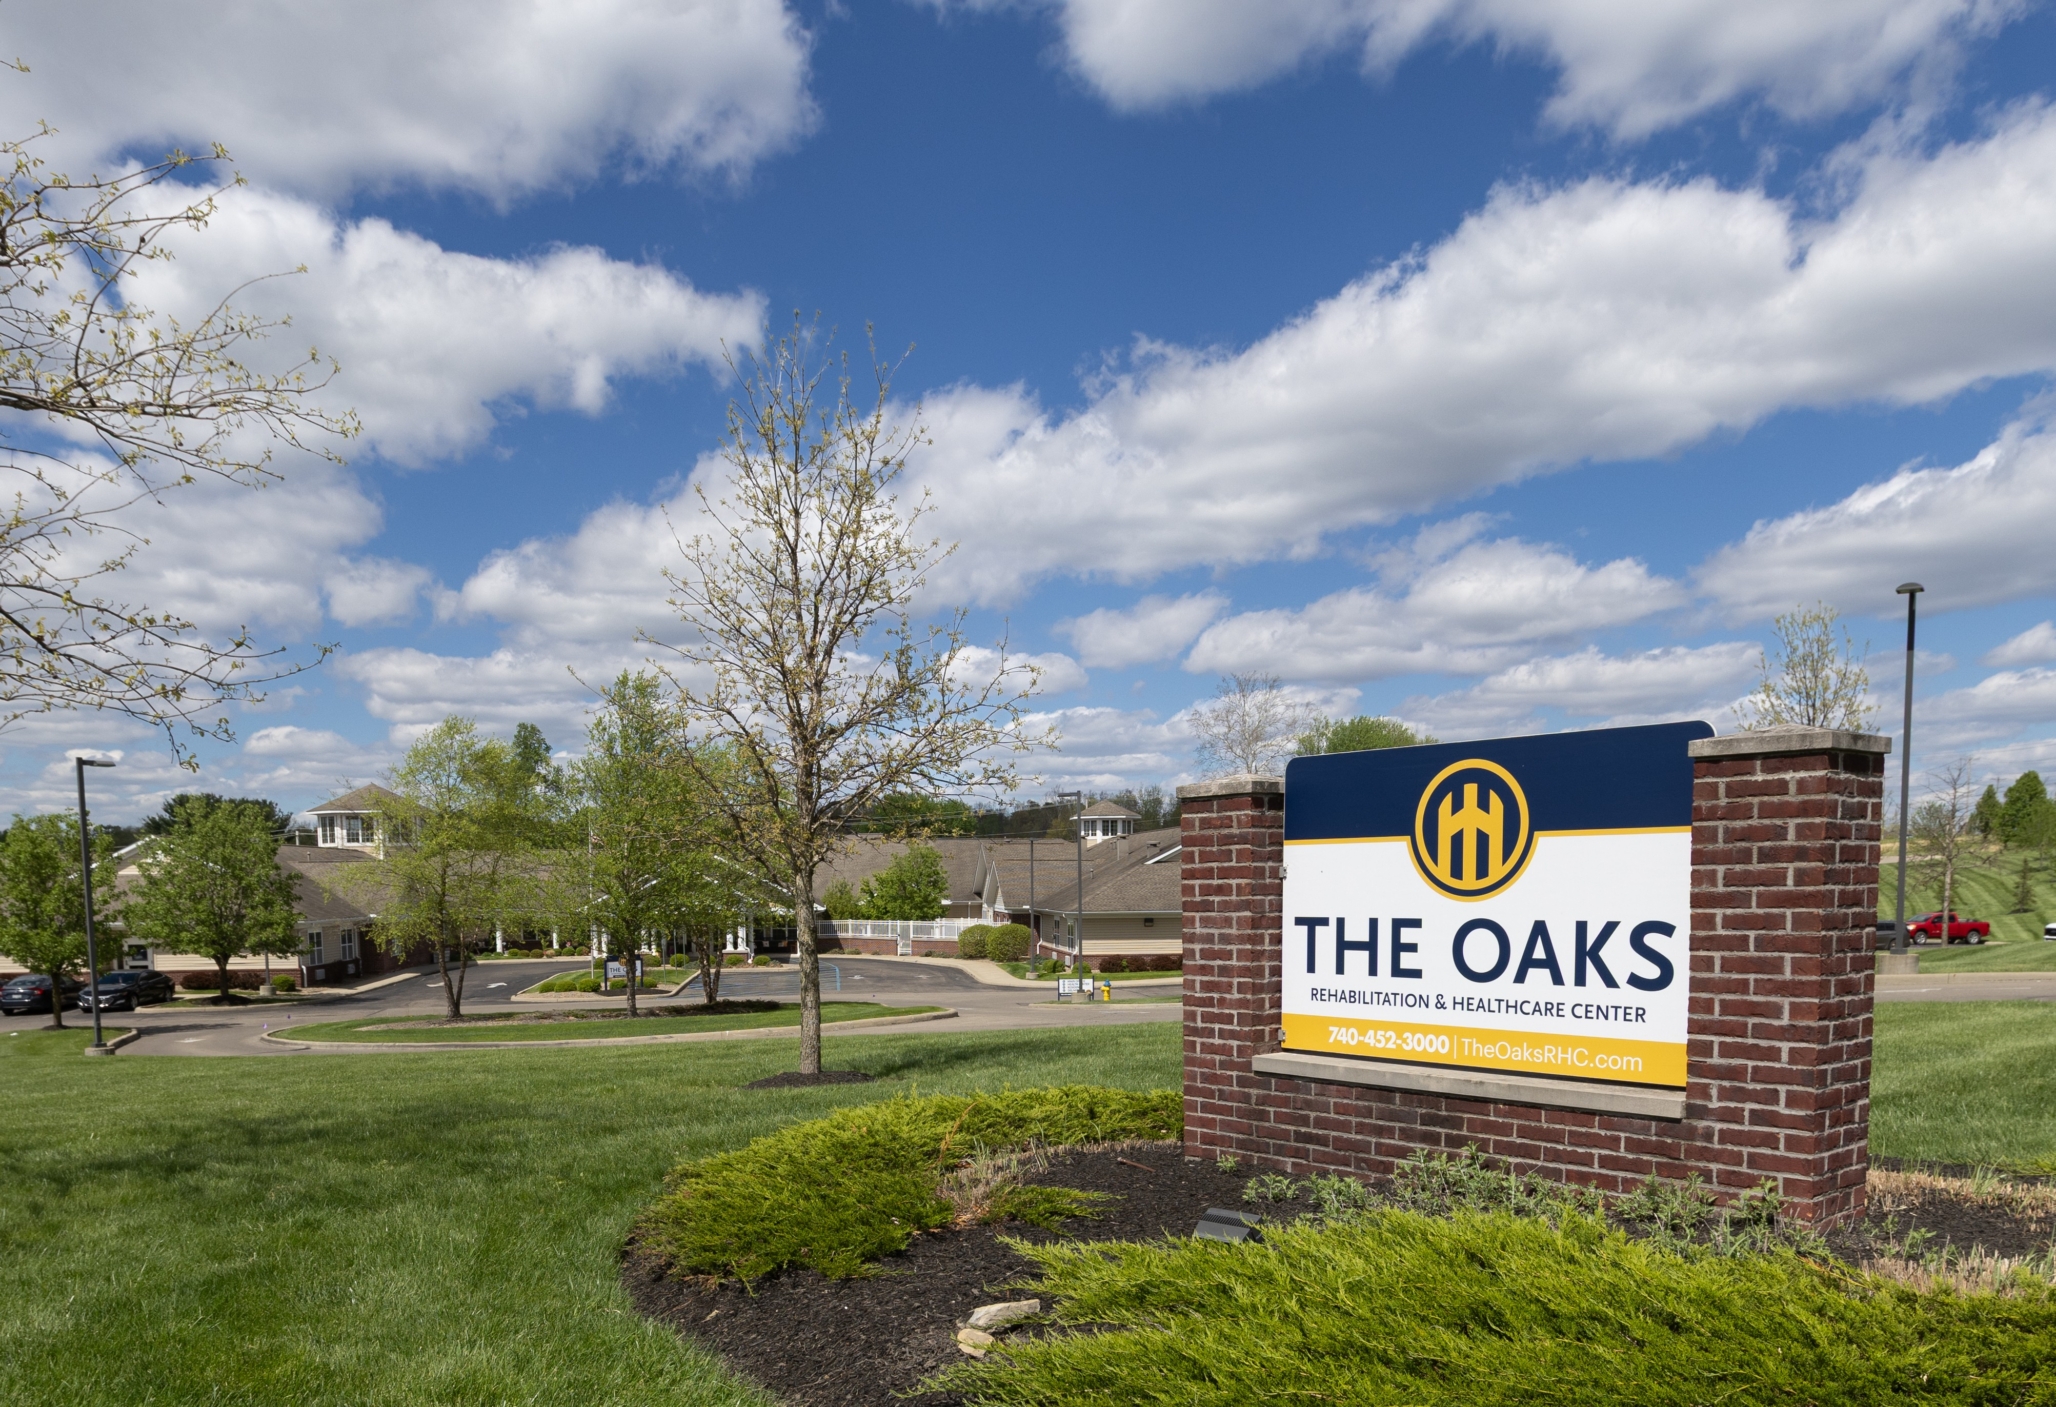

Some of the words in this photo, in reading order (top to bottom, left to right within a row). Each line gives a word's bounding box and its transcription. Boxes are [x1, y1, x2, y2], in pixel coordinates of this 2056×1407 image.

[1294, 916, 1423, 979] THE
[1452, 917, 1677, 992] OAKS
[1310, 987, 1430, 1009] REHABILITATION
[1434, 993, 1448, 1010] &
[1452, 995, 1566, 1018] HEALTHCARE
[1570, 1002, 1647, 1024] CENTER
[1327, 1025, 1449, 1054] 740-452-3000
[1460, 1037, 1643, 1072] TheOaksRHC.com
